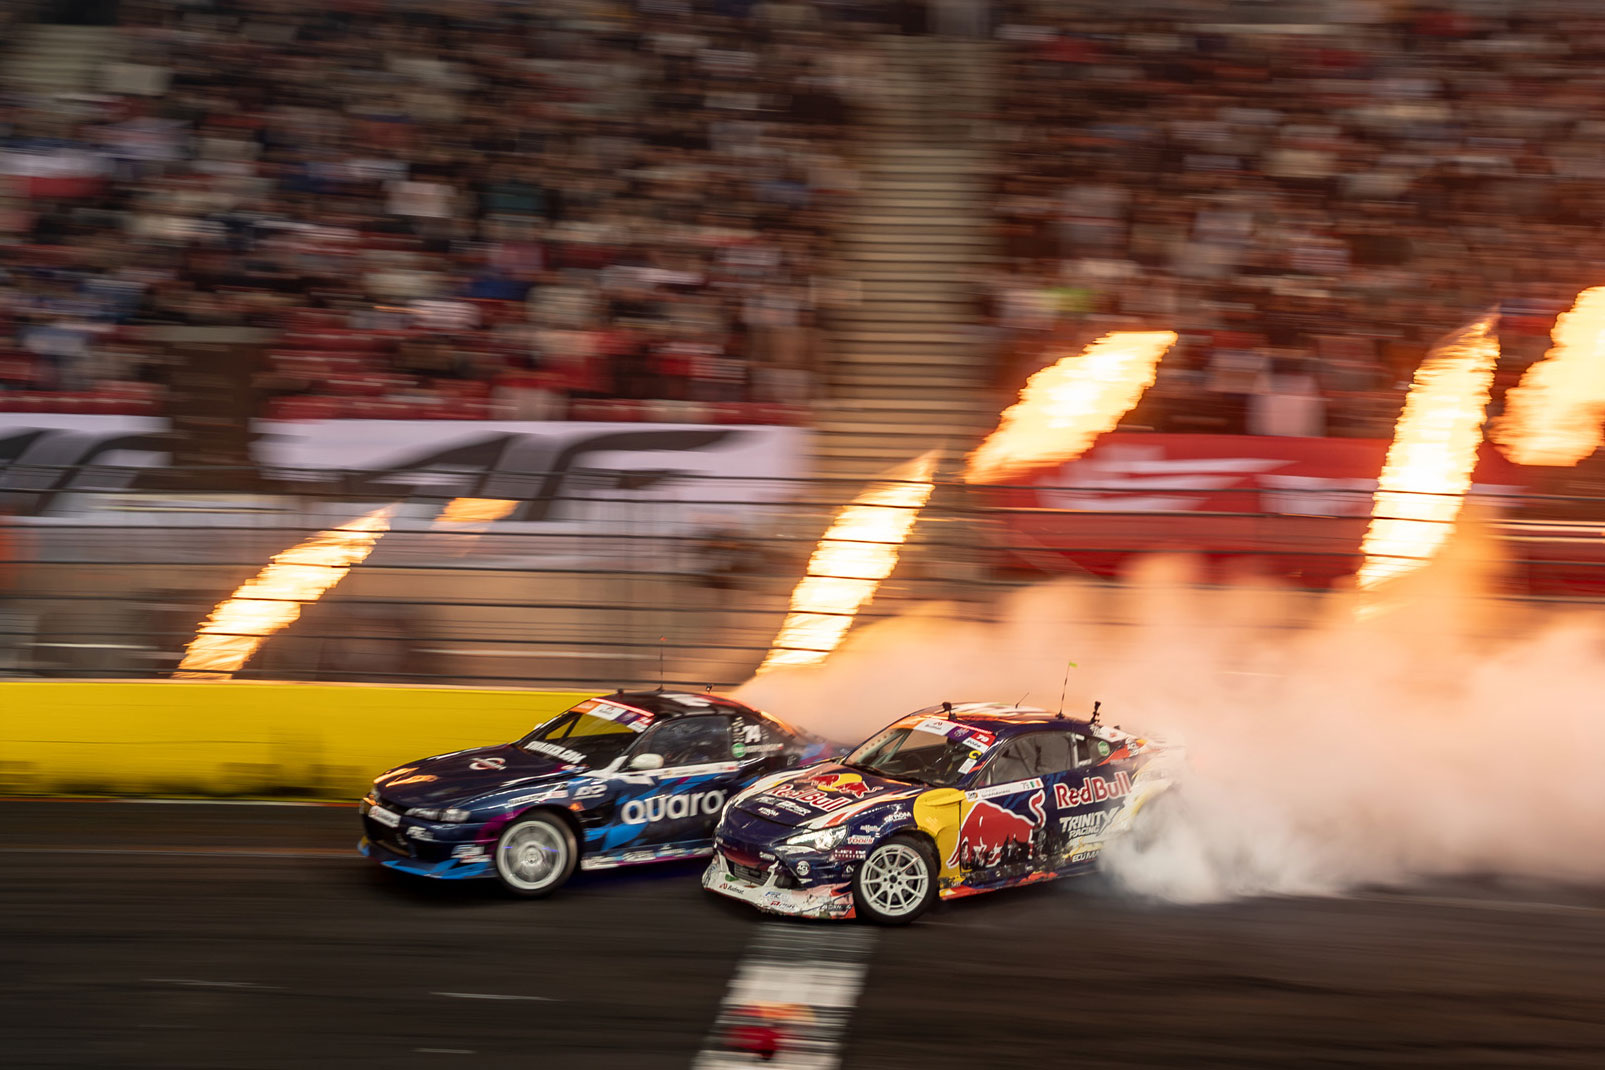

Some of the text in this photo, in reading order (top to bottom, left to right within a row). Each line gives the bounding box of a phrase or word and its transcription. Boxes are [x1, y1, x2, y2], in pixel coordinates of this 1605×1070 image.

[765, 784, 804, 800] Red
[797, 789, 853, 812] Bull
[1053, 771, 1132, 810] Red Bull
[1059, 806, 1120, 836] TRINITY
[1069, 825, 1100, 839] RACING
